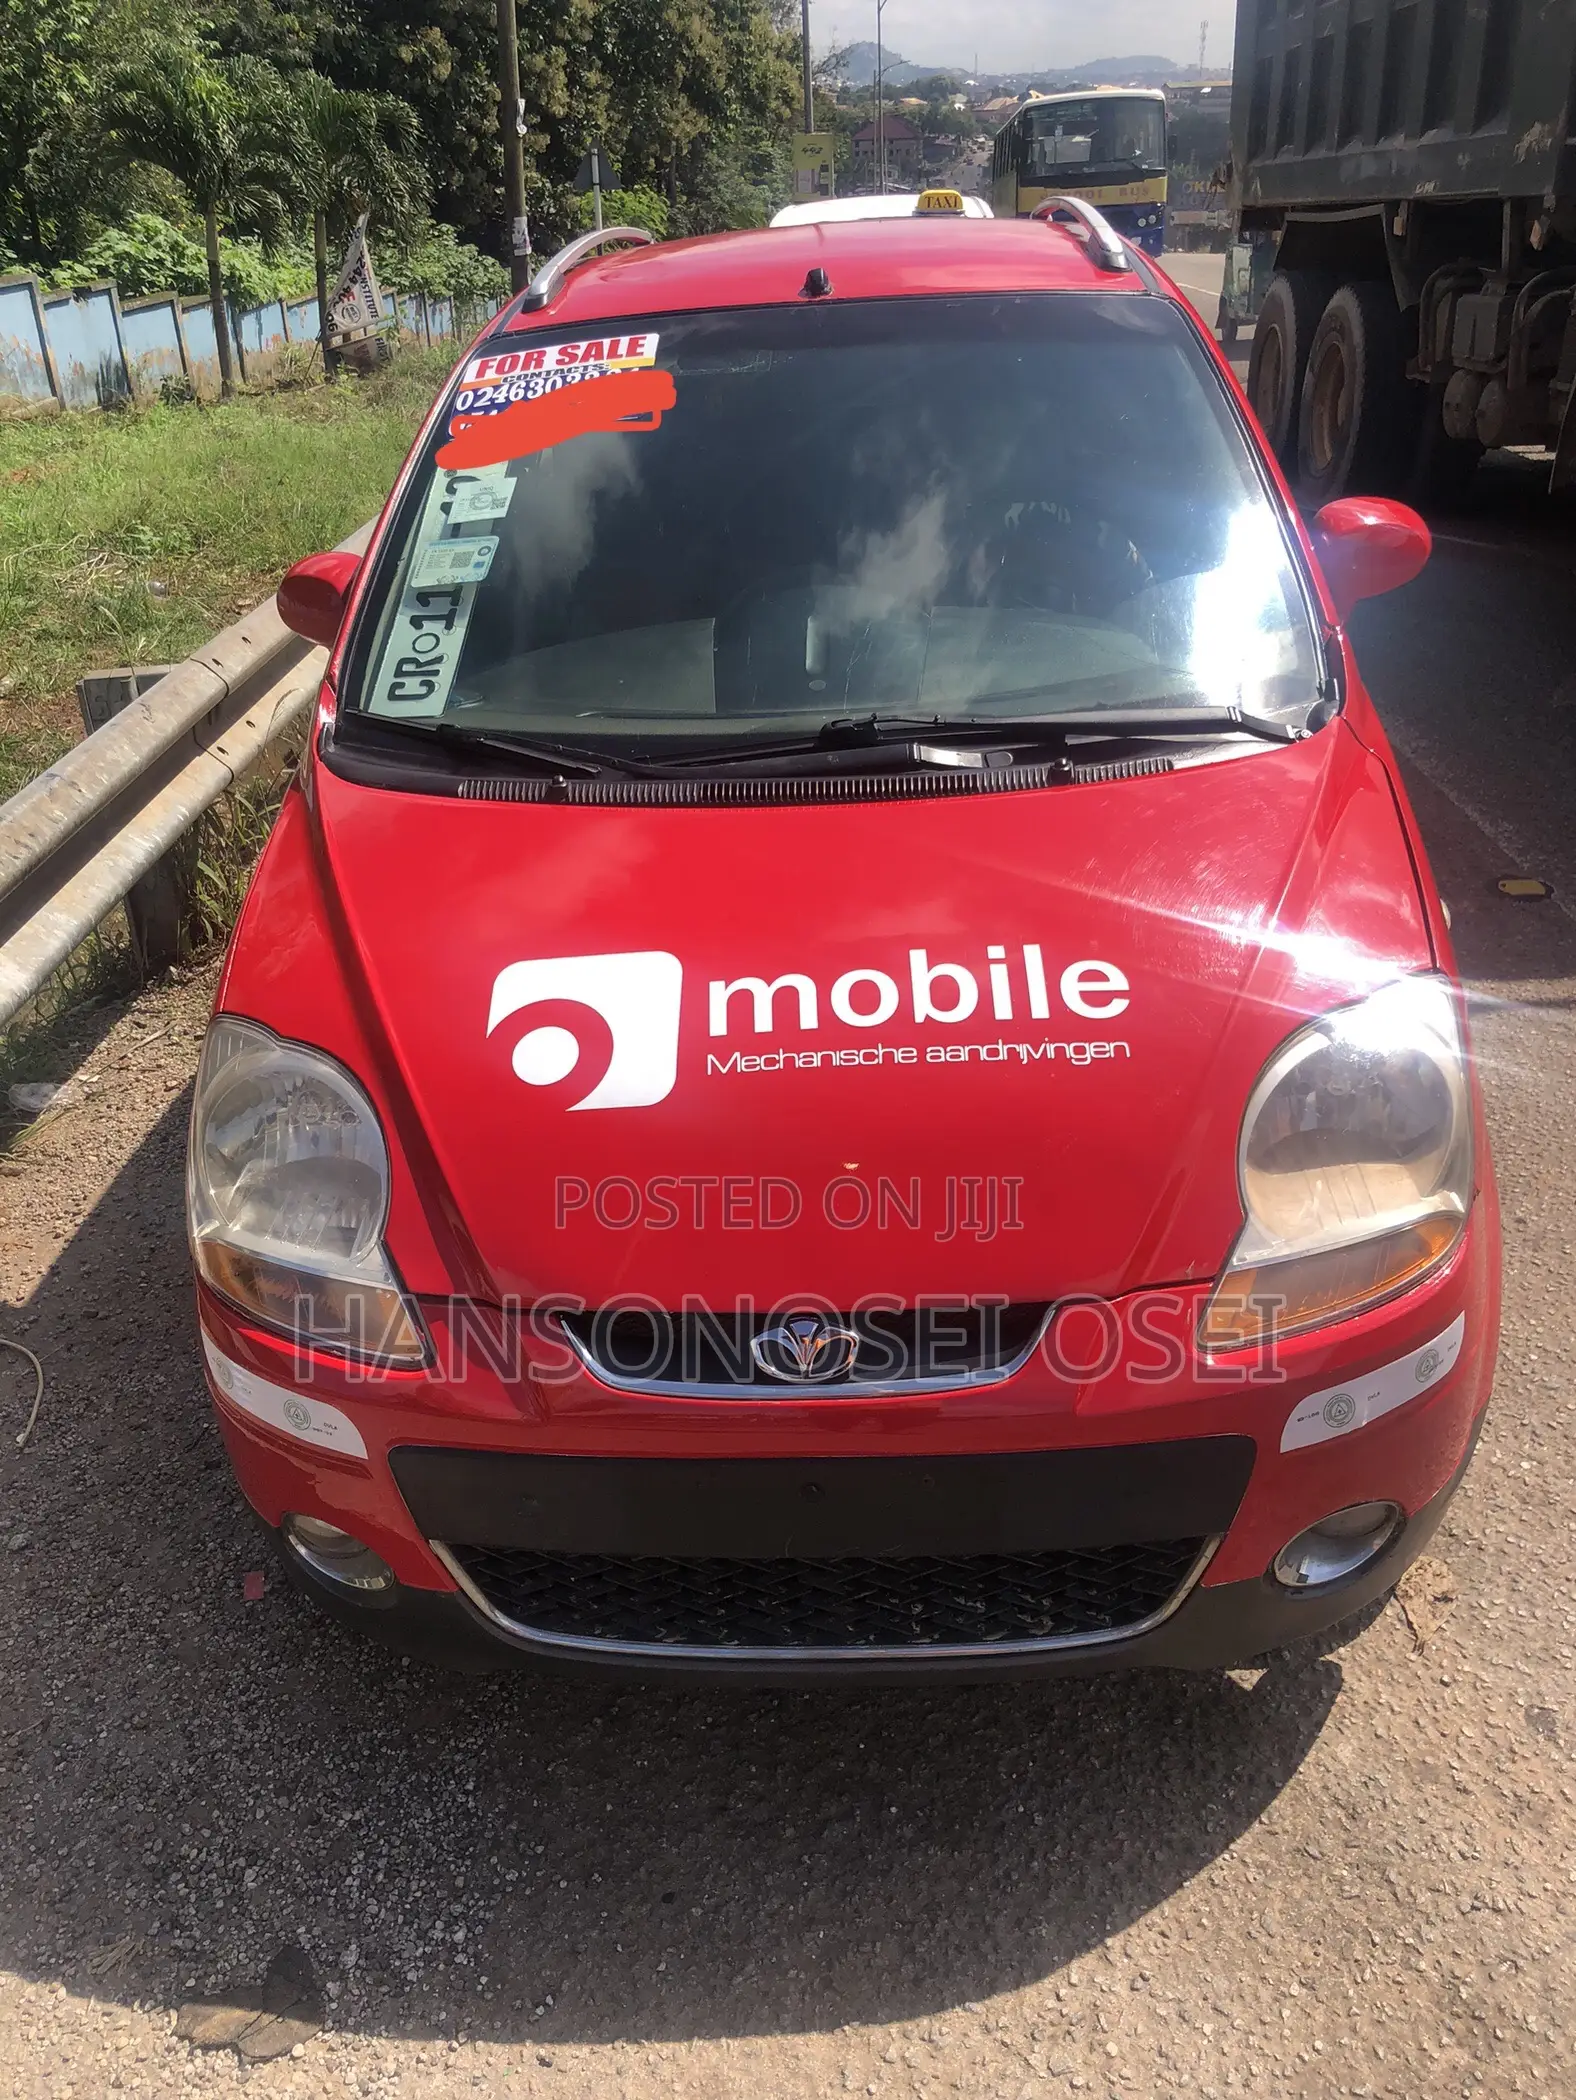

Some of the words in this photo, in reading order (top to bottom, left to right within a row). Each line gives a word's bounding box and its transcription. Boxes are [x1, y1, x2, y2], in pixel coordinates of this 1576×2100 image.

[924, 195, 958, 209] TAXI
[360, 273, 380, 319] NSTITUTE
[475, 349, 547, 380] FOR
[555, 335, 648, 366] SALE
[501, 362, 610, 385] CONTACTS:
[708, 943, 1131, 1037] mobile
[706, 1043, 918, 1076] Mechanische
[925, 1037, 1131, 1066] aandrijvingen
